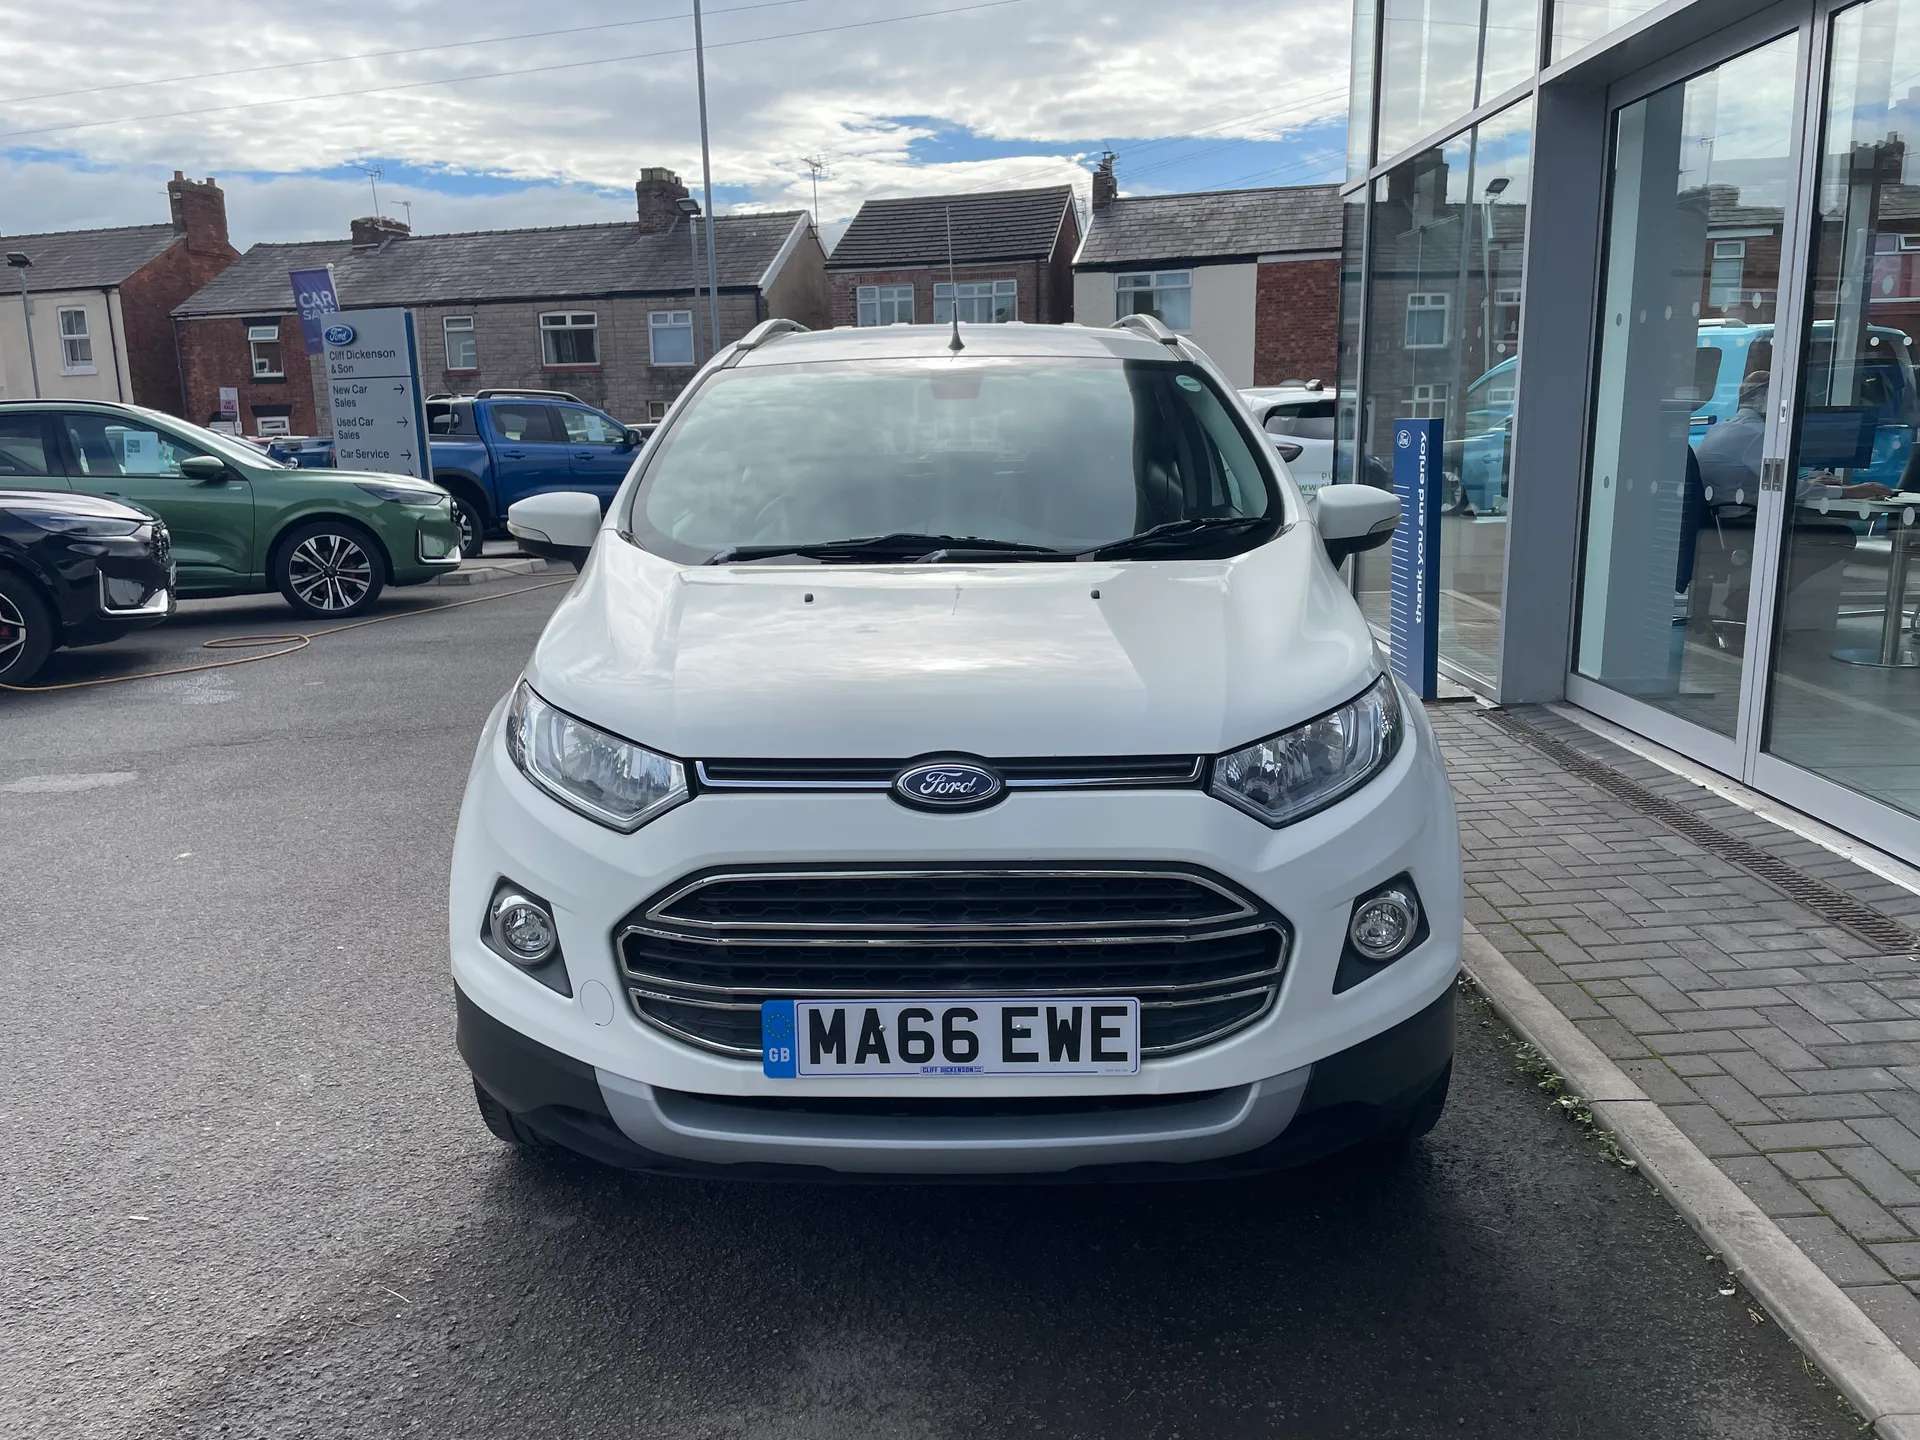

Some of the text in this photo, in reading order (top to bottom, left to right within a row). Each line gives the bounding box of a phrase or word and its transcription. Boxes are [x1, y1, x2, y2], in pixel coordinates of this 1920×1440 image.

[299, 290, 335, 309] CAR
[329, 349, 396, 361] Cliff Dickenson
[331, 364, 354, 374] & Son
[332, 384, 368, 395] New Car
[334, 399, 357, 408] Sales
[336, 416, 374, 427] Used Car
[338, 430, 360, 440] Sales
[340, 449, 390, 459] Car Service
[1419, 431, 1427, 485] enjoy
[1415, 569, 1424, 624] thank
[920, 771, 978, 795] Ford
[808, 1006, 1129, 1065] MA66 EWE
[768, 1047, 791, 1063] GB
[922, 1065, 938, 1073] CLIFF
